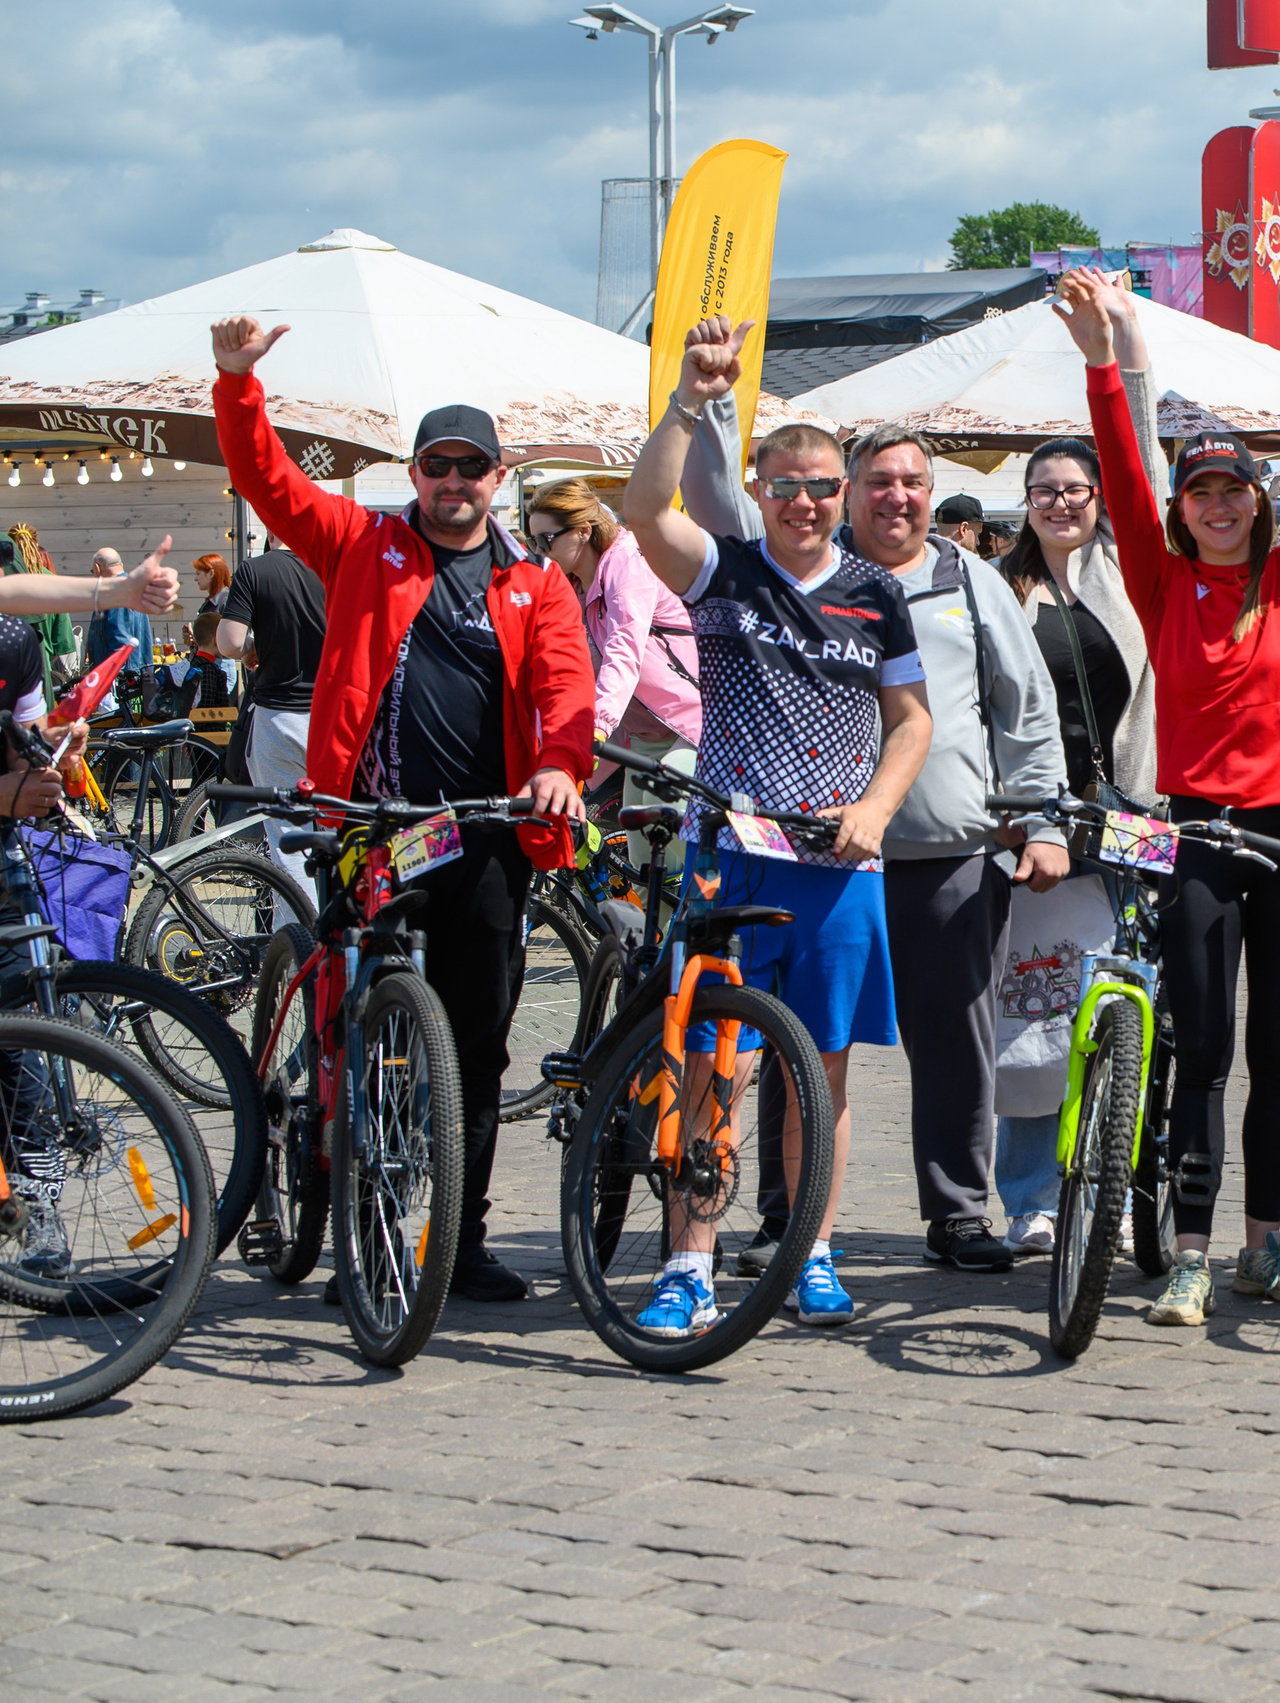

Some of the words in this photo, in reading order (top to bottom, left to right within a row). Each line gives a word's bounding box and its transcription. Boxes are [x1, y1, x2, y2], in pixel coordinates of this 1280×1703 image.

[700, 215, 721, 314] обслуживаем
[716, 266, 728, 298] 2013
[723, 231, 734, 264] года
[0, 1391, 55, 1406] KEND
